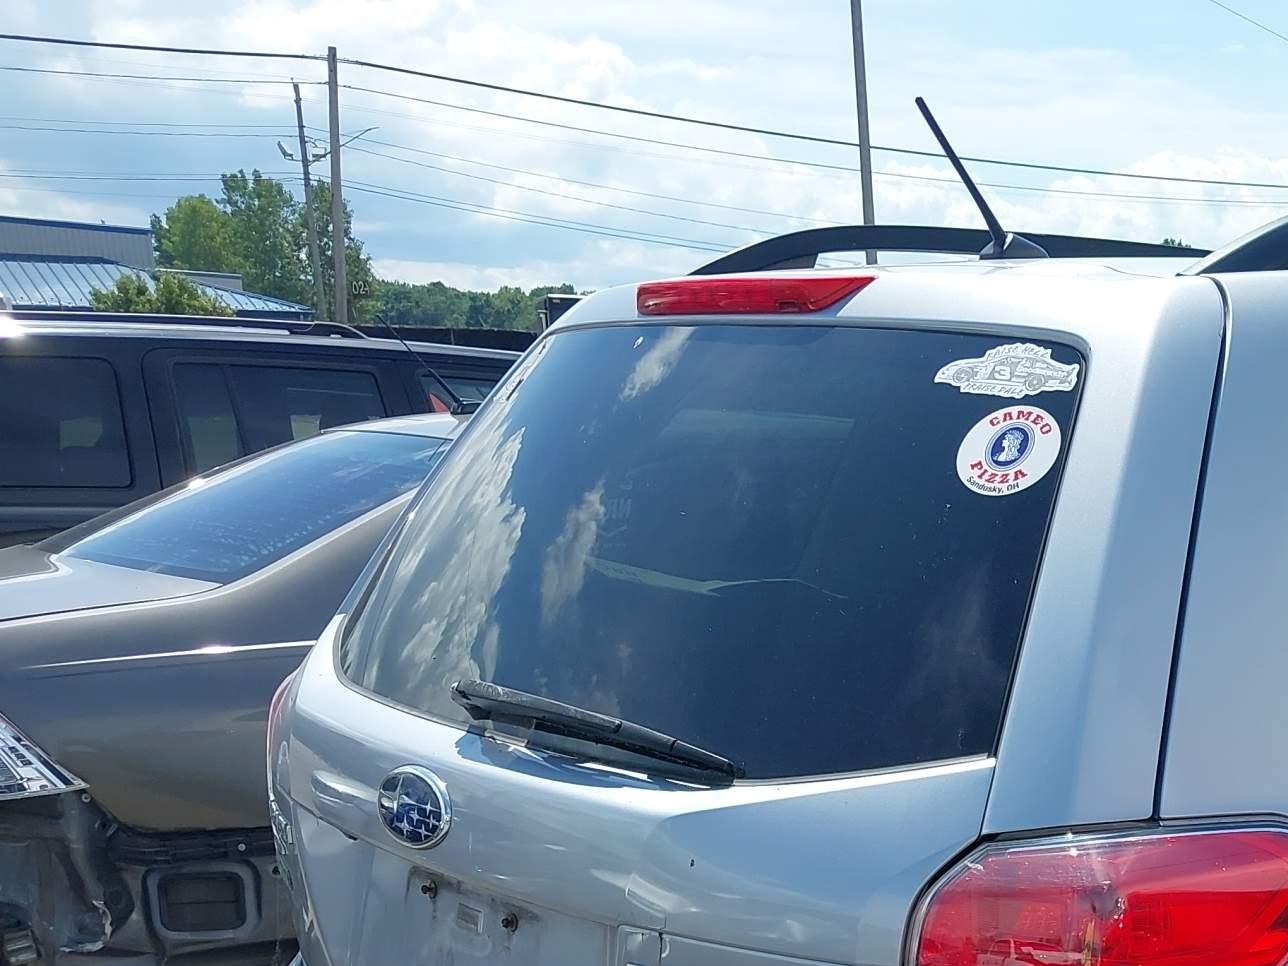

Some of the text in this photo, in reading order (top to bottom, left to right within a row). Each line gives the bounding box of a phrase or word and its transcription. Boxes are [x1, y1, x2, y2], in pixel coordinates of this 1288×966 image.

[993, 366, 1011, 380] 3
[989, 410, 1053, 436] CAMEO
[970, 459, 1028, 484] PIZZA
[1006, 481, 1020, 491] OH
